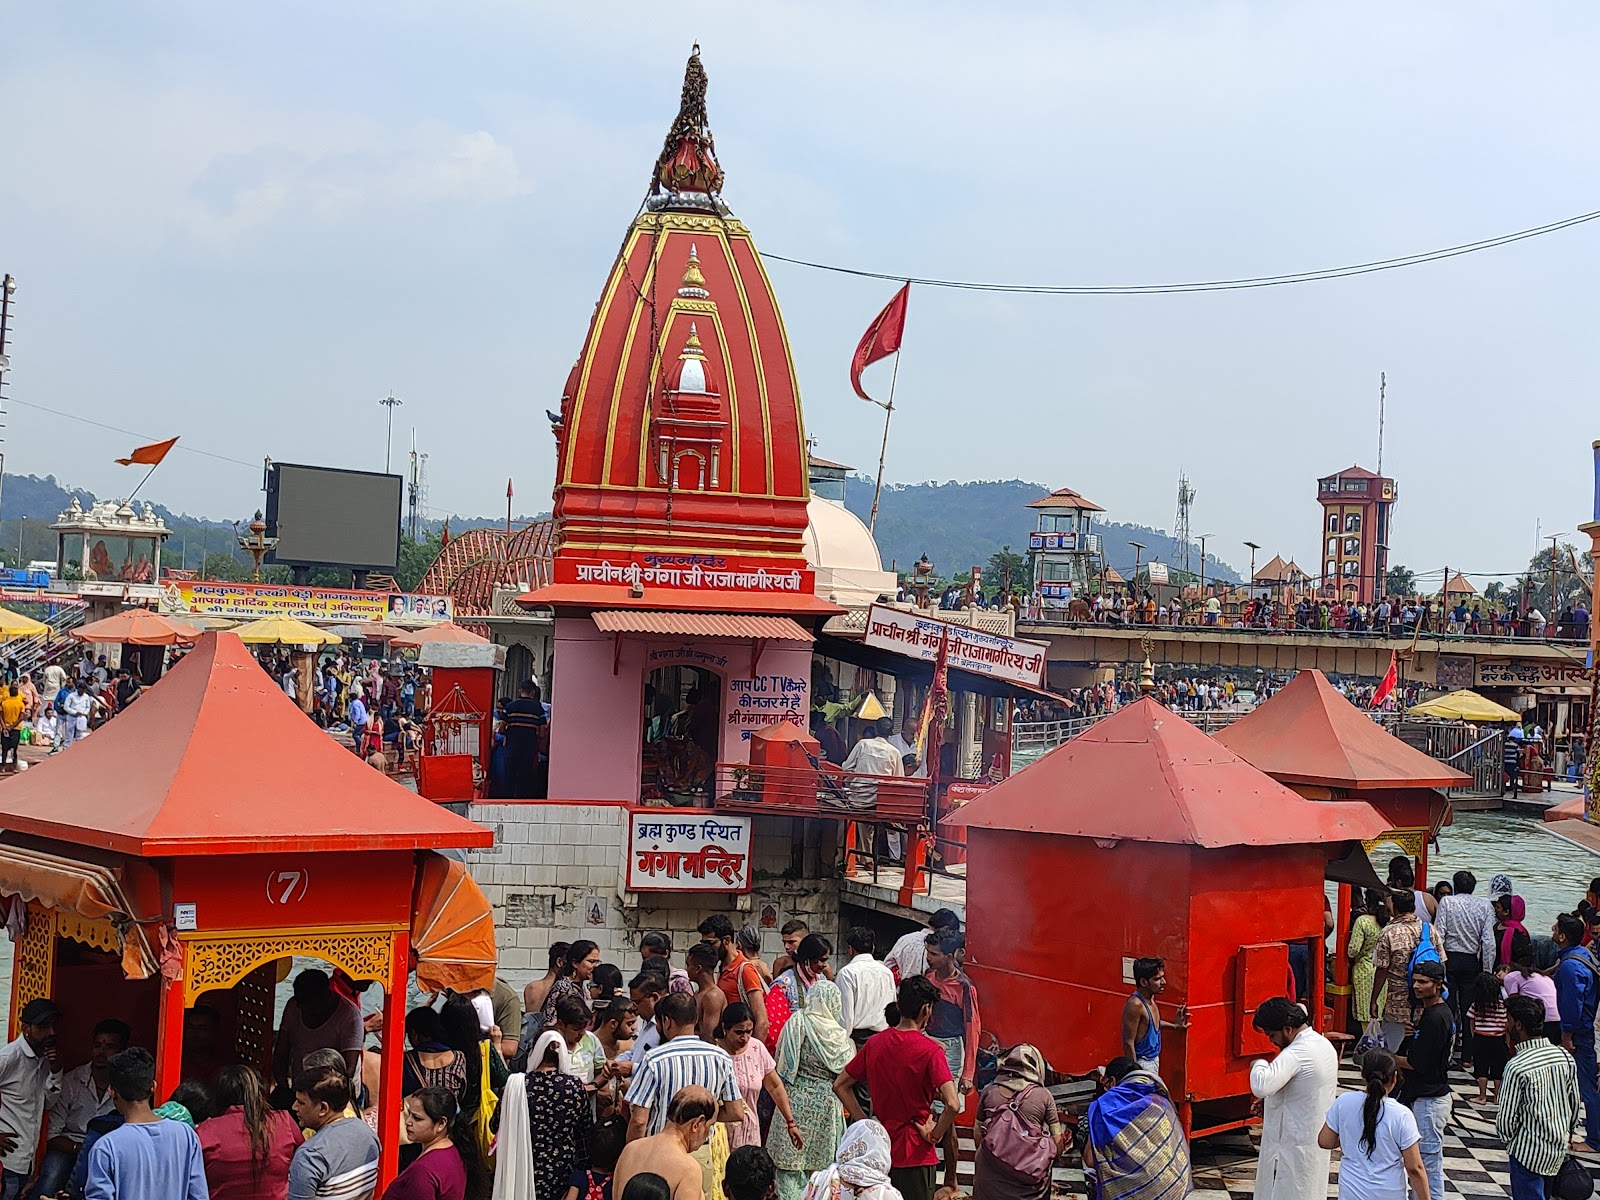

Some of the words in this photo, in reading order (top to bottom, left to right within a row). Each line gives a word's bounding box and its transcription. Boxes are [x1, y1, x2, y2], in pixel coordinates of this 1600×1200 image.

[190, 596, 230, 605] आपका
[233, 596, 268, 607] हार्दिक
[272, 601, 308, 609] स्वागत
[312, 601, 327, 610] एवं
[330, 602, 384, 612] अभिनन्दन
[317, 593, 362, 602] आगमन
[366, 594, 382, 602] पर
[870, 621, 906, 641] प्राचीन
[1541, 664, 1592, 683] आस्थ
[730, 679, 752, 691] आप
[787, 677, 807, 693] कैमरे
[738, 693, 752, 708] की
[753, 697, 779, 708] नजर
[779, 693, 790, 708] में
[728, 708, 741, 725] श्री
[742, 710, 761, 725] गंगा
[761, 714, 779, 725] माता
[638, 823, 662, 840] ब्रह्म
[665, 824, 697, 842] कुण्ड
[700, 820, 743, 841] स्थित
[636, 844, 682, 880] गंगा
[682, 844, 745, 885] मन्दिर
